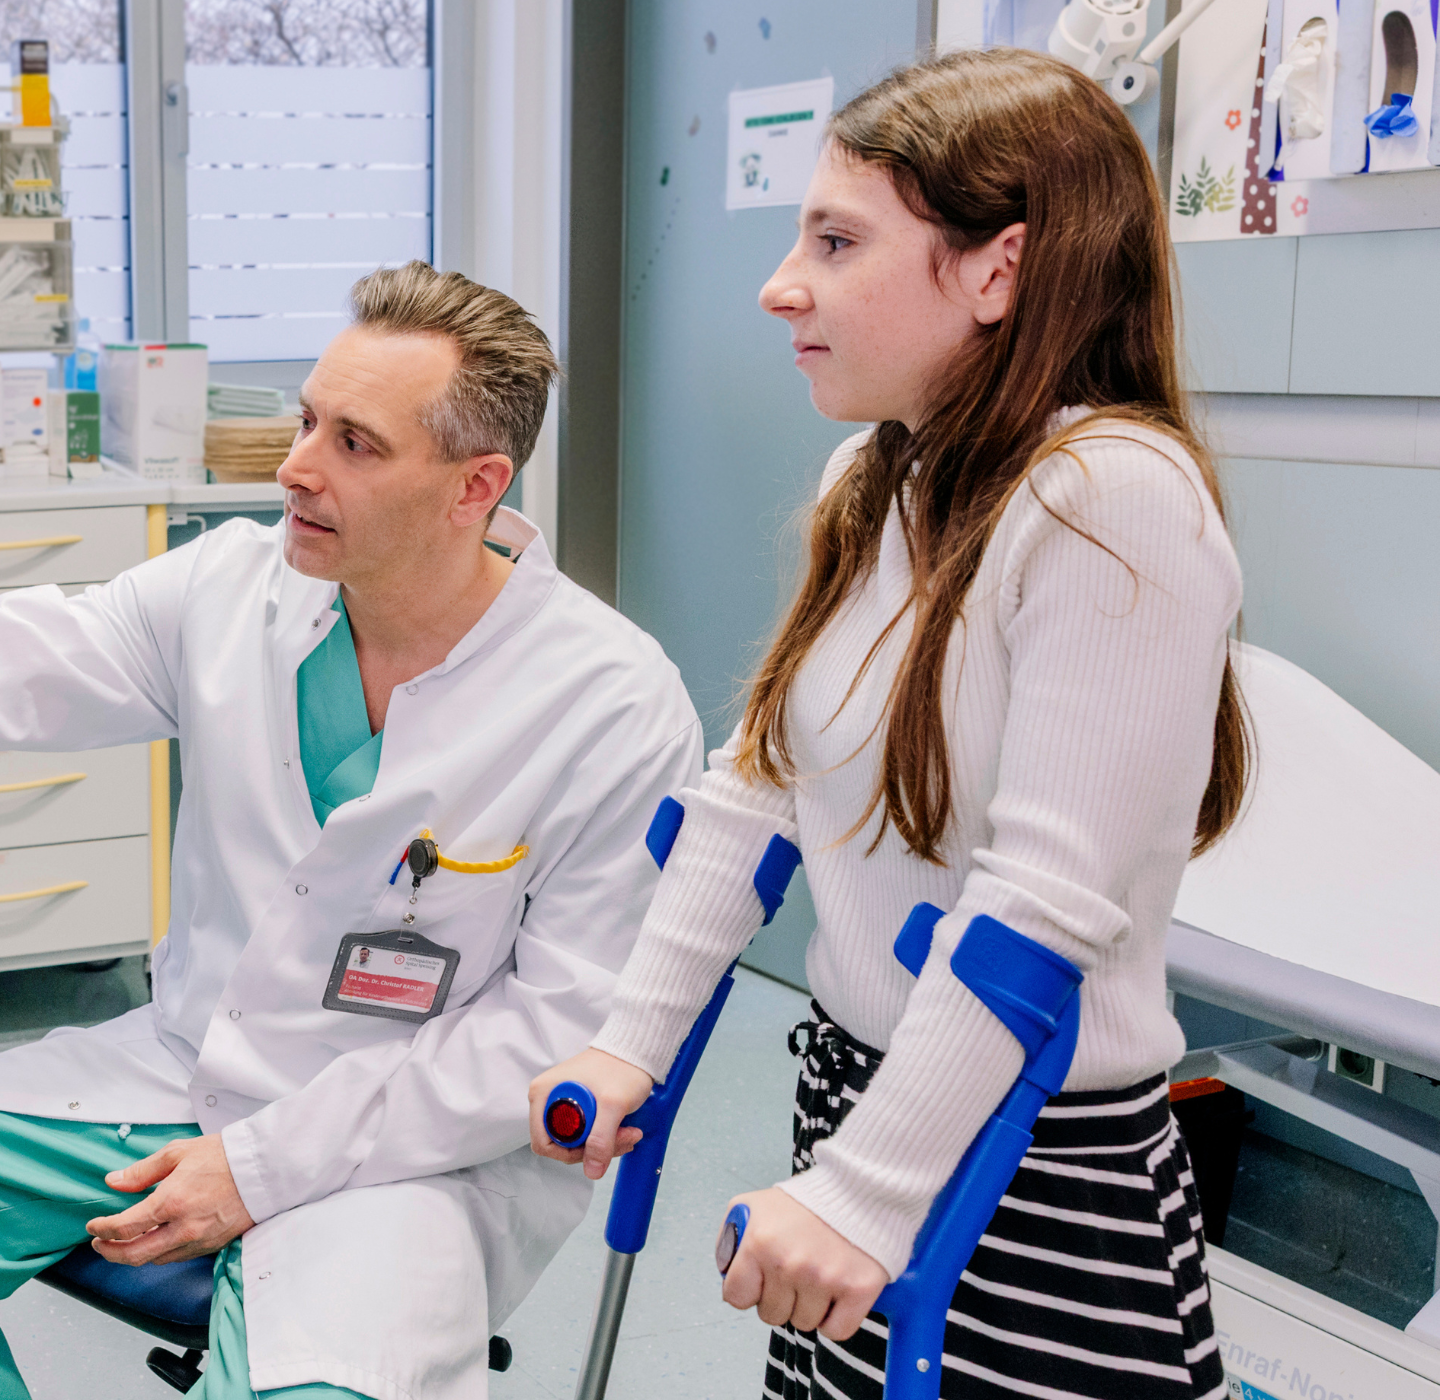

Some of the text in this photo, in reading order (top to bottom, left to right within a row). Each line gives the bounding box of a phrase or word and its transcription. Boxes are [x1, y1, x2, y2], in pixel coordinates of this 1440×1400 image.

[381, 980, 402, 989] Christof
[403, 984, 424, 992] RADLER
[1215, 1329, 1354, 1400] Enraf-No
